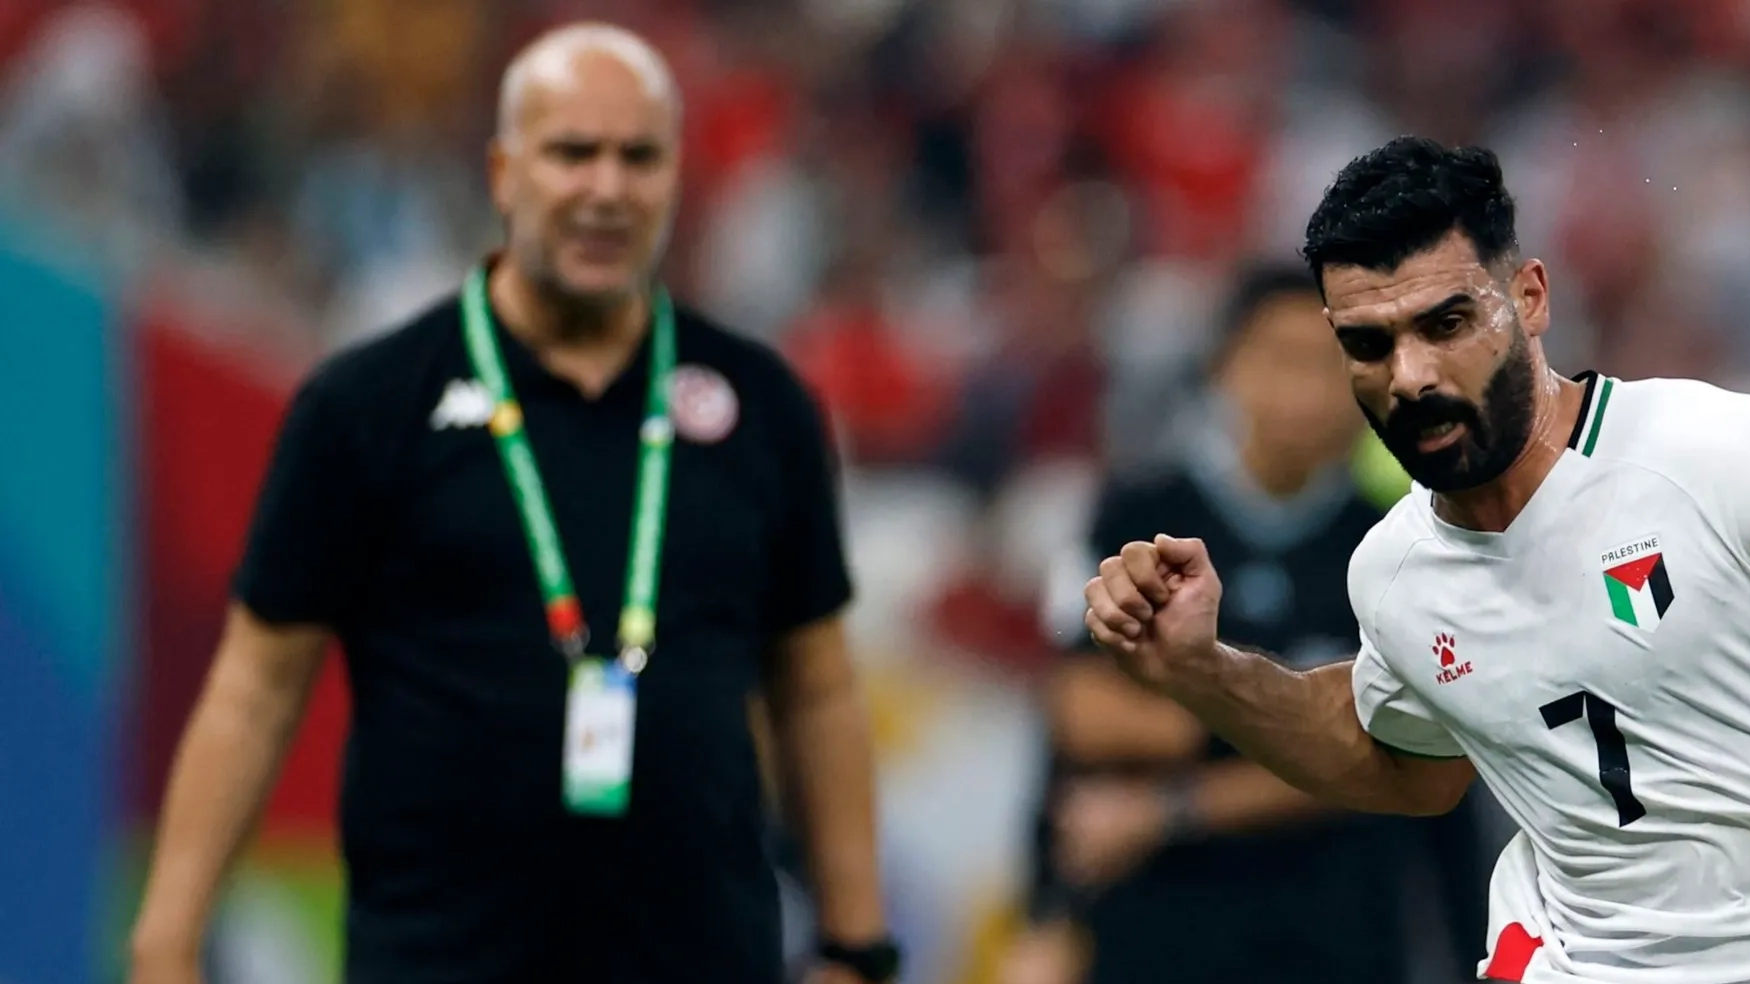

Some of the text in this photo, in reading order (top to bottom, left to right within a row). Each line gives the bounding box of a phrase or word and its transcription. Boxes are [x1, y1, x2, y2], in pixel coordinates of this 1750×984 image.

[1601, 538, 1659, 564] PALESTINE
[1436, 661, 1473, 685] KELME
[1539, 690, 1646, 827] 7
